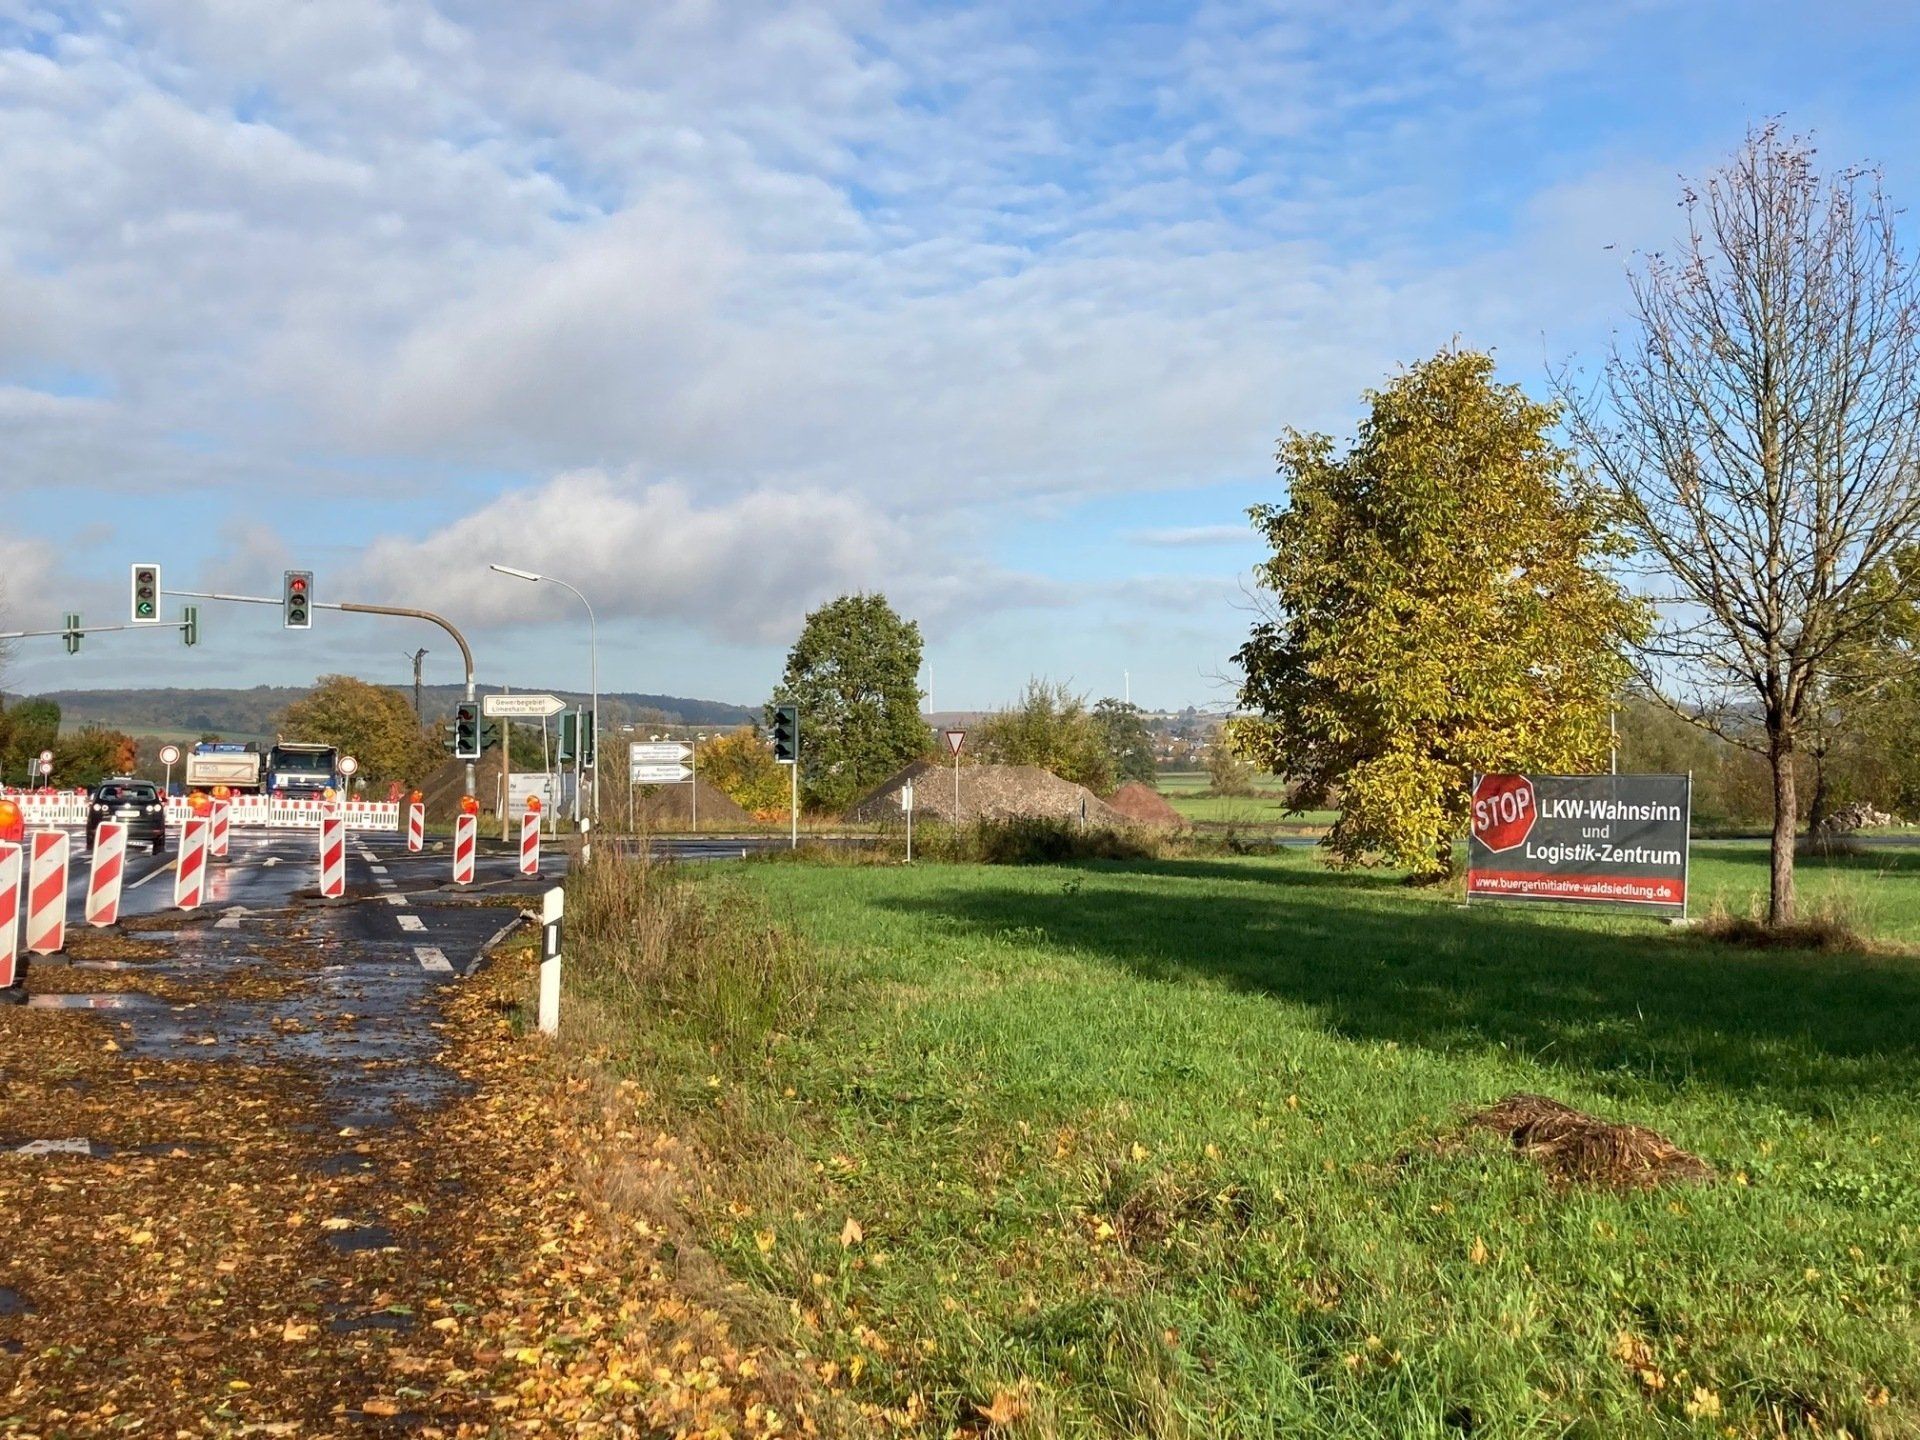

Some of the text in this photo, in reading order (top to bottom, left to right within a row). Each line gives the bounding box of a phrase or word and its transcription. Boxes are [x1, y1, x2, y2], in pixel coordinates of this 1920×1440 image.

[1476, 788, 1529, 831] STOP
[1542, 799, 1680, 821] LKW-Wahnsinn
[1583, 825, 1609, 839] und
[1526, 842, 1681, 864] Logistik-Zentrum
[1476, 877, 1671, 898] www.buergerinitiative-waldsiedlung.de
